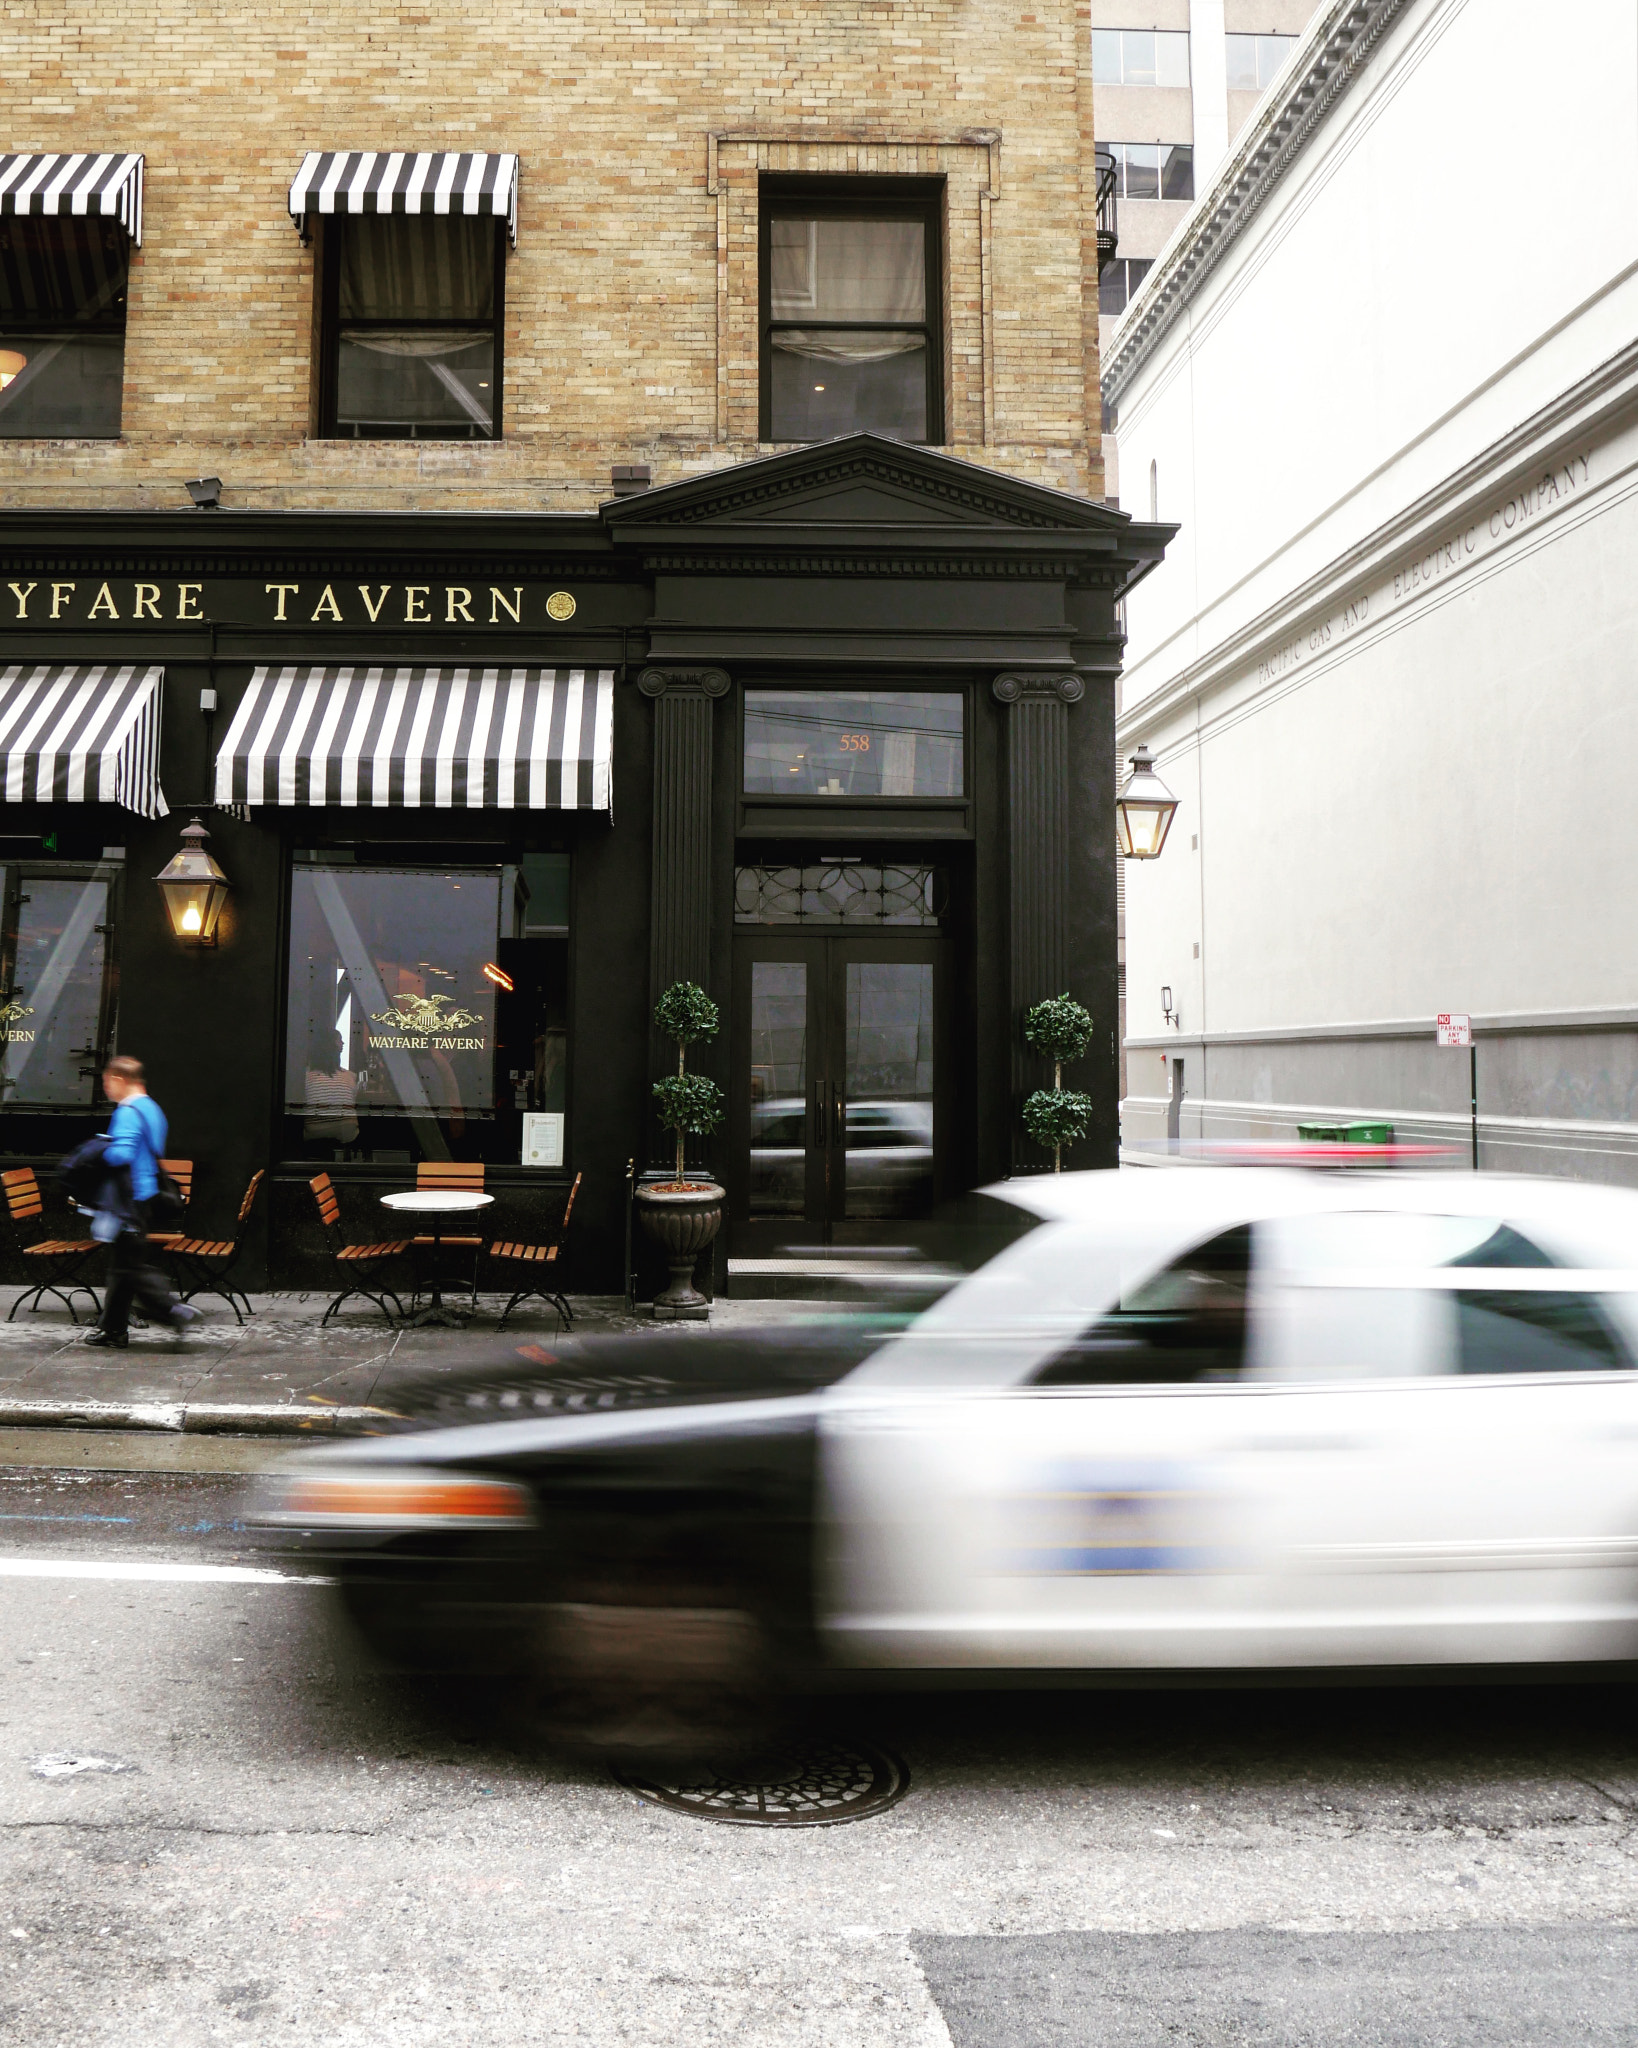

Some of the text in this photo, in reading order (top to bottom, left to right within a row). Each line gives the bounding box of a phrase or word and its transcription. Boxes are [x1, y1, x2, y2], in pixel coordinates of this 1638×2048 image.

[1258, 448, 1592, 684] PACIFIC GAS AND ELECTRIC COMPANY
[8, 582, 524, 623] YFARE TAVERN
[840, 734, 870, 751] 558
[1439, 1015, 1450, 1024] NO
[369, 1036, 485, 1050] WAYFARE TAVERN
